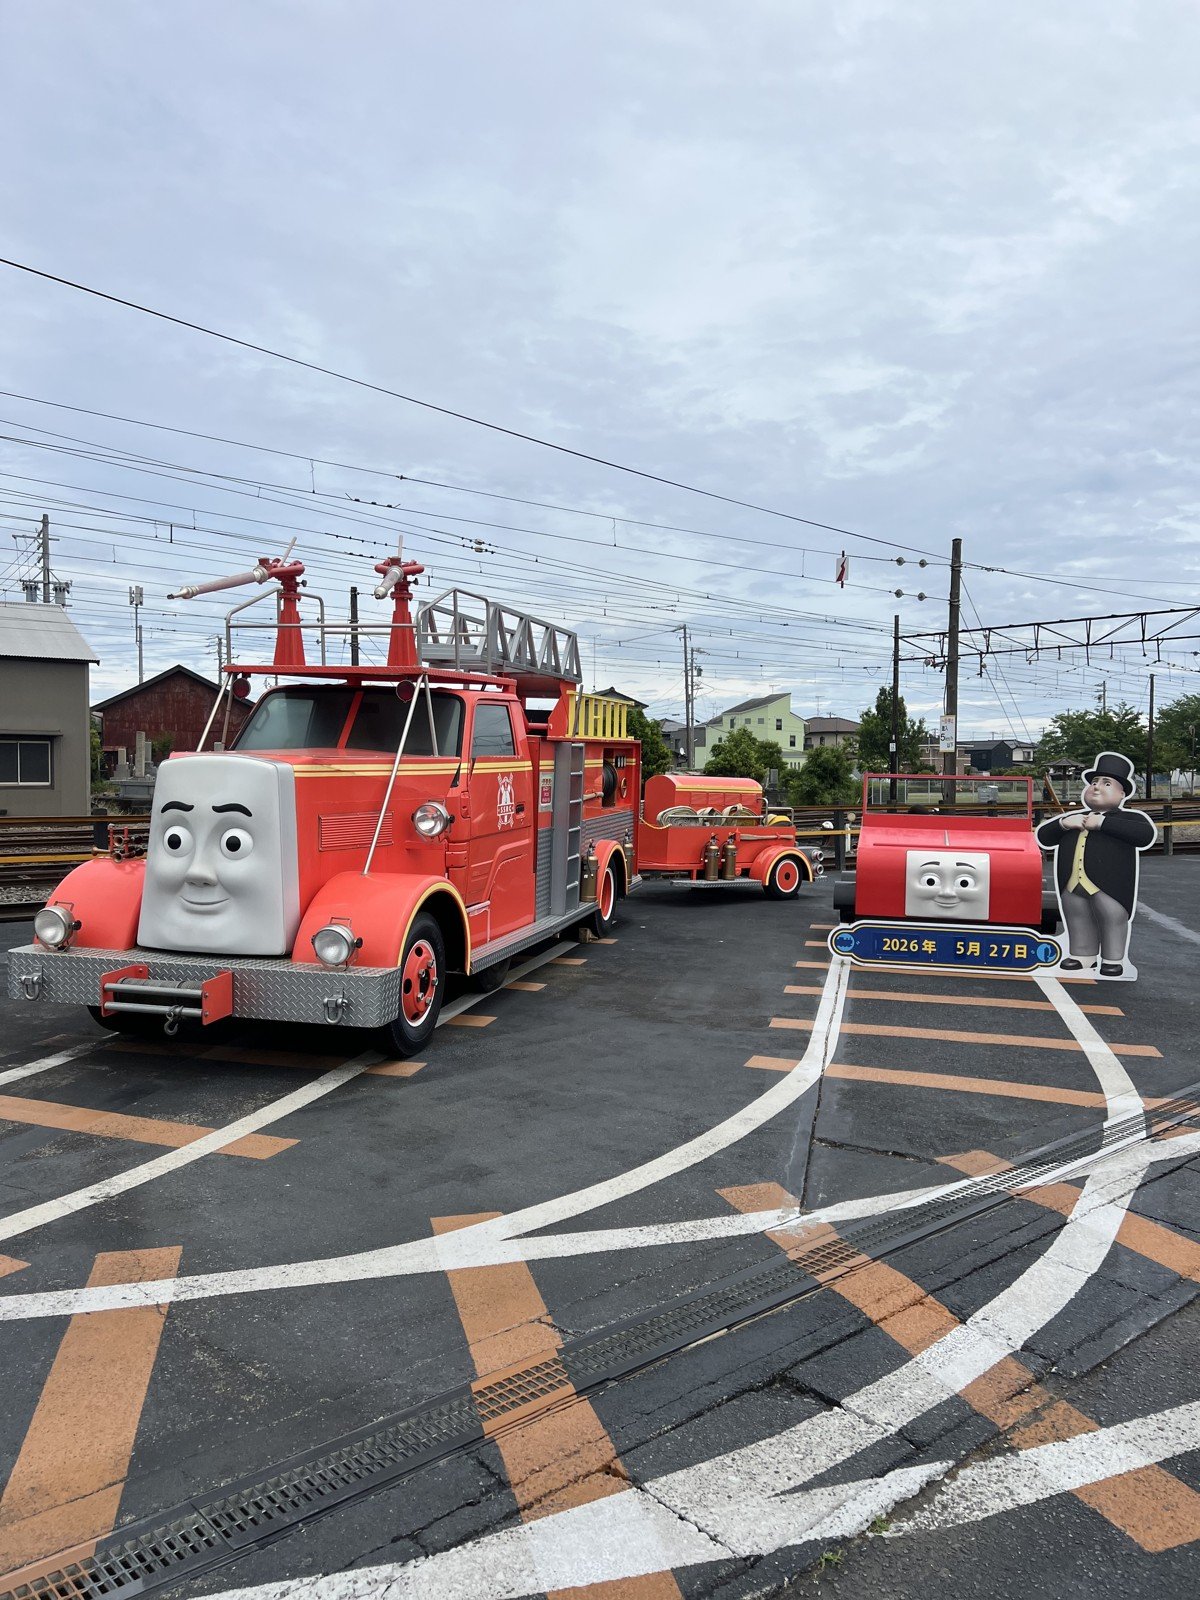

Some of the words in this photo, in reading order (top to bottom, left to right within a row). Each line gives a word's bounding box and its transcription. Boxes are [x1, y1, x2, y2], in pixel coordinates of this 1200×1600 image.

[882, 938, 936, 954] 2026年
[956, 942, 980, 956] 5月
[989, 944, 1027, 958] 27日
